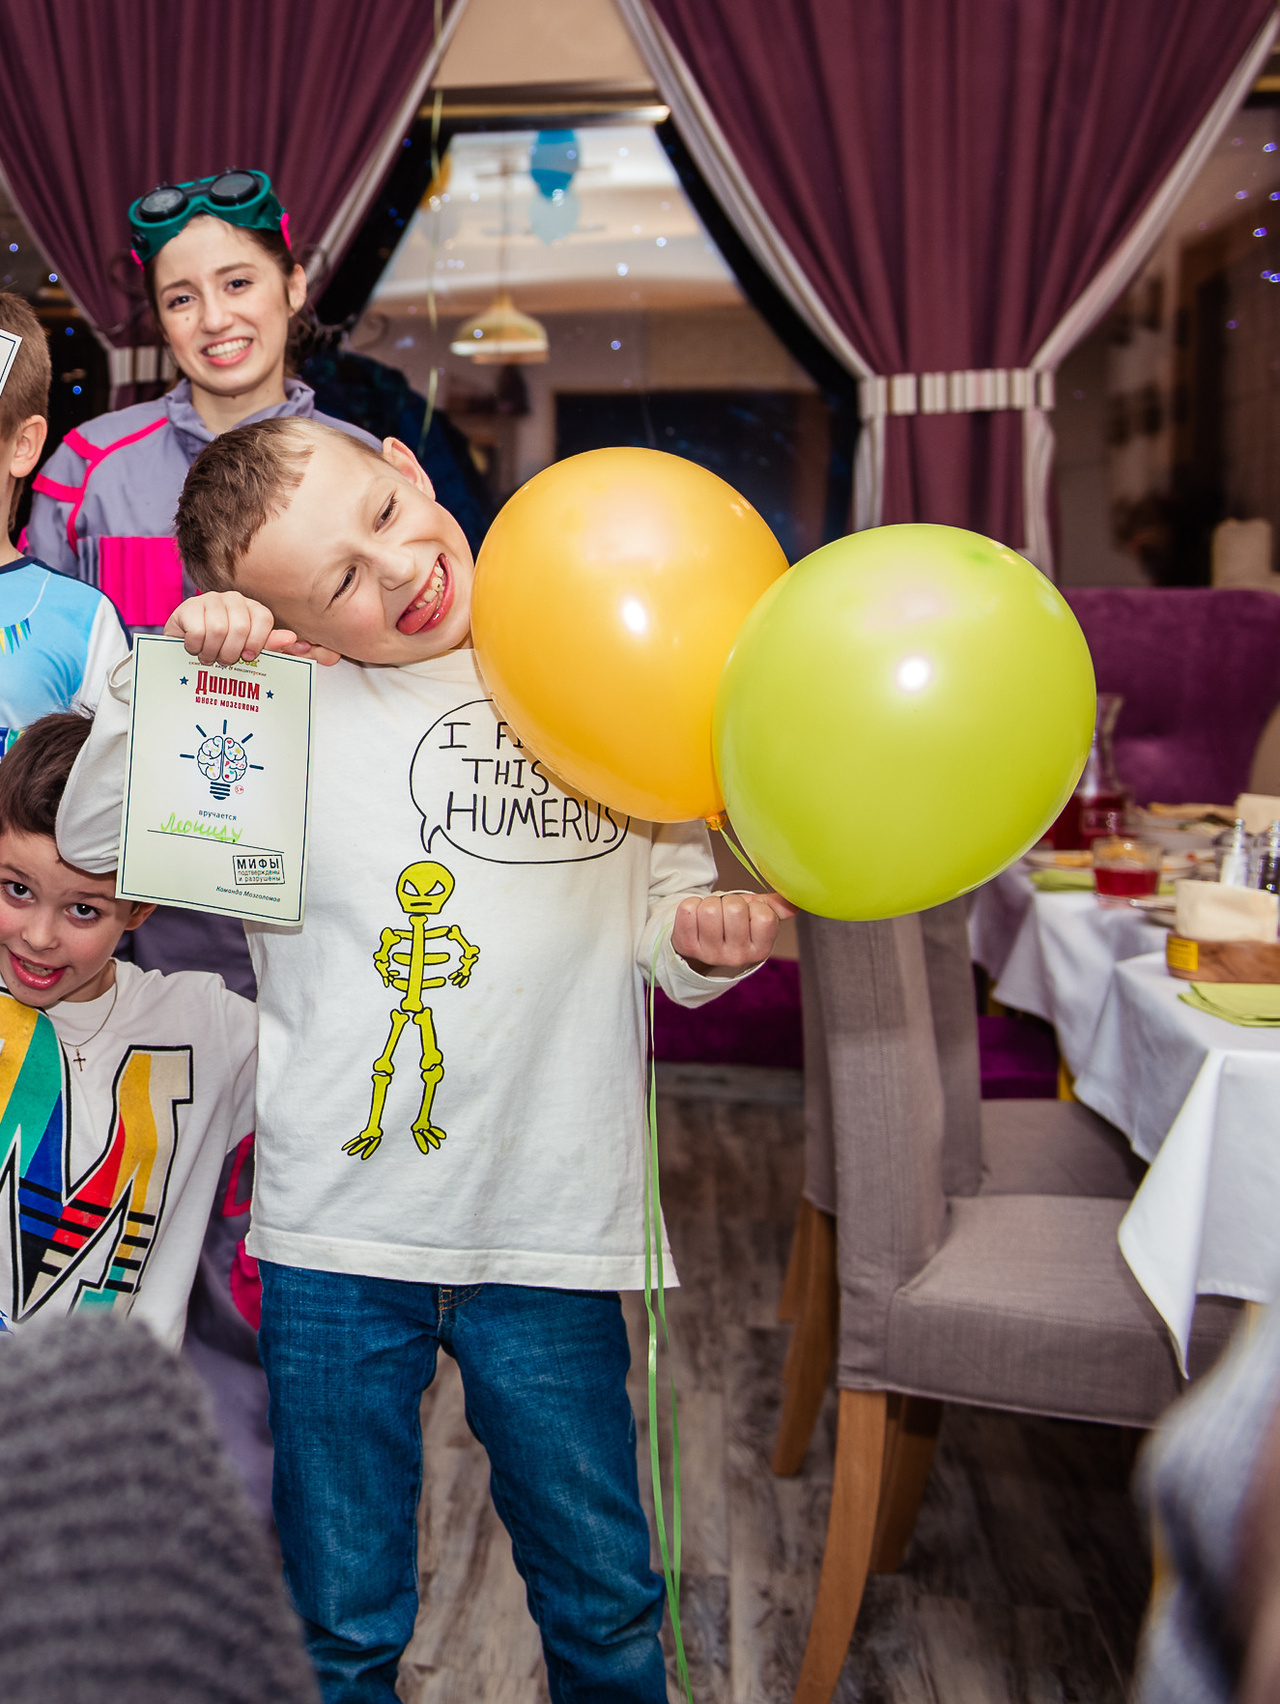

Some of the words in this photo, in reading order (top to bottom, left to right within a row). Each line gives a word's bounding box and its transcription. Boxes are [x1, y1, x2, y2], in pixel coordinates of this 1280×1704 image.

[195, 670, 261, 701] Диплом
[439, 722, 471, 749] I
[461, 757, 550, 796] THIS
[198, 809, 238, 821] вручается
[446, 791, 619, 844] HUMERUS
[236, 857, 280, 870] МИФЫ
